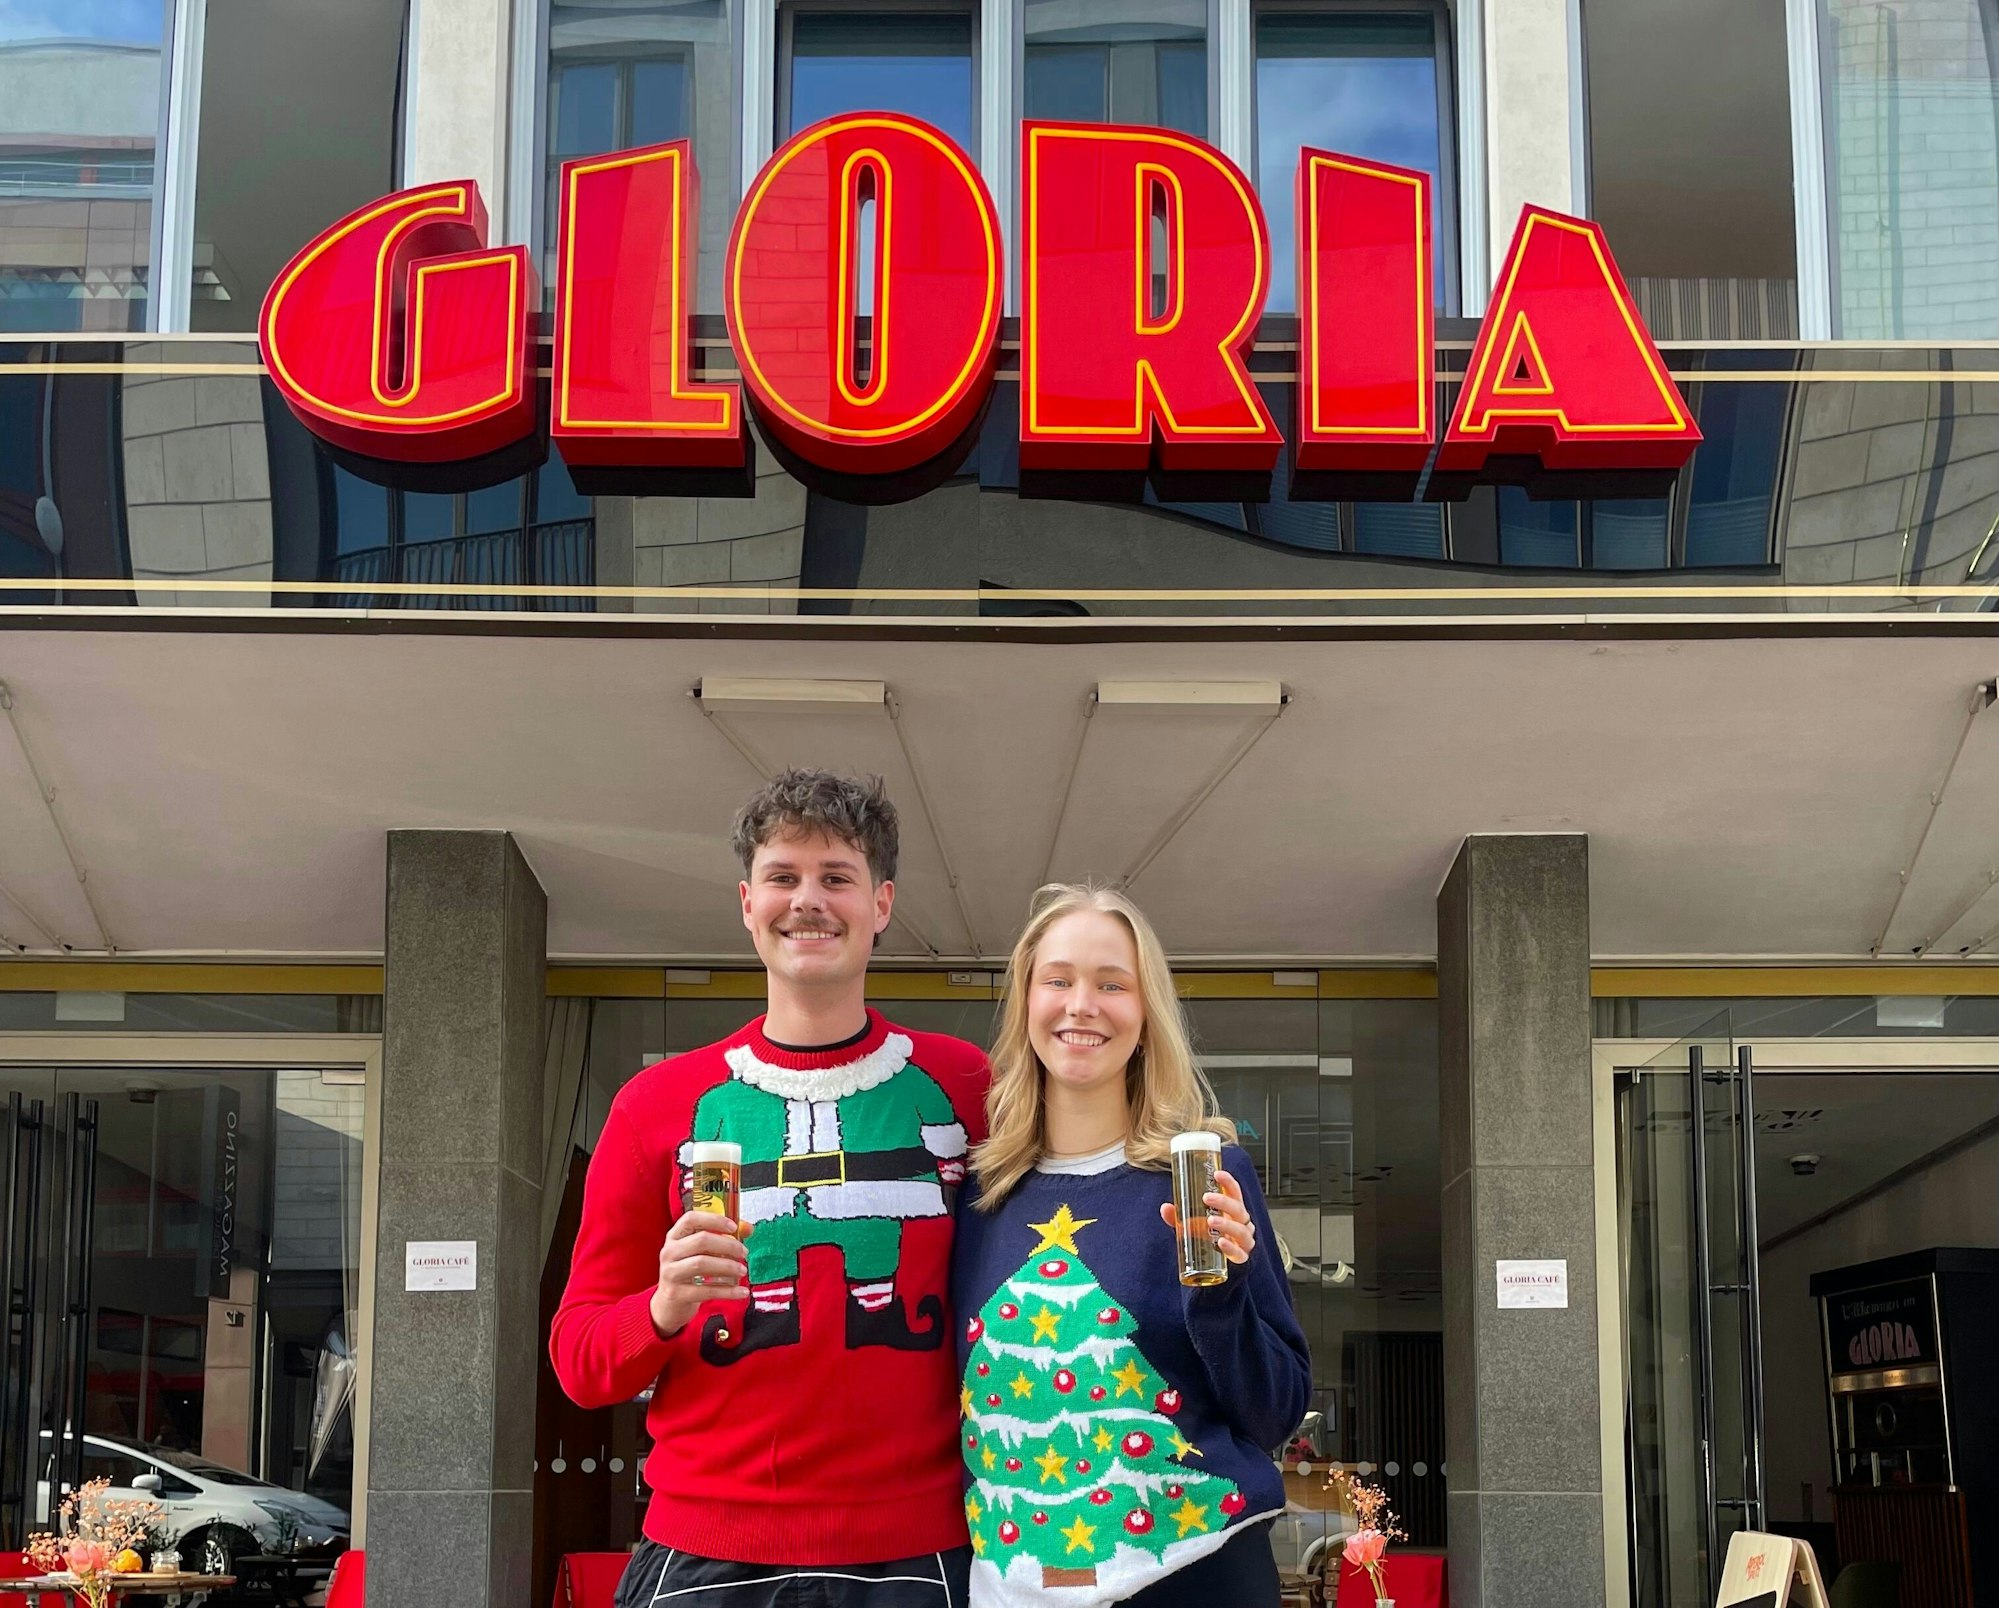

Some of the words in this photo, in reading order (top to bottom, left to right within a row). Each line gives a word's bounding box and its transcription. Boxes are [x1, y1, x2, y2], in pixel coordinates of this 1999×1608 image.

[259, 110, 1703, 480] GLORIA
[412, 1258, 445, 1267] GLORIA
[1503, 1276, 1536, 1284] GLORIA
[1849, 1321, 1921, 1365] GLORIA
